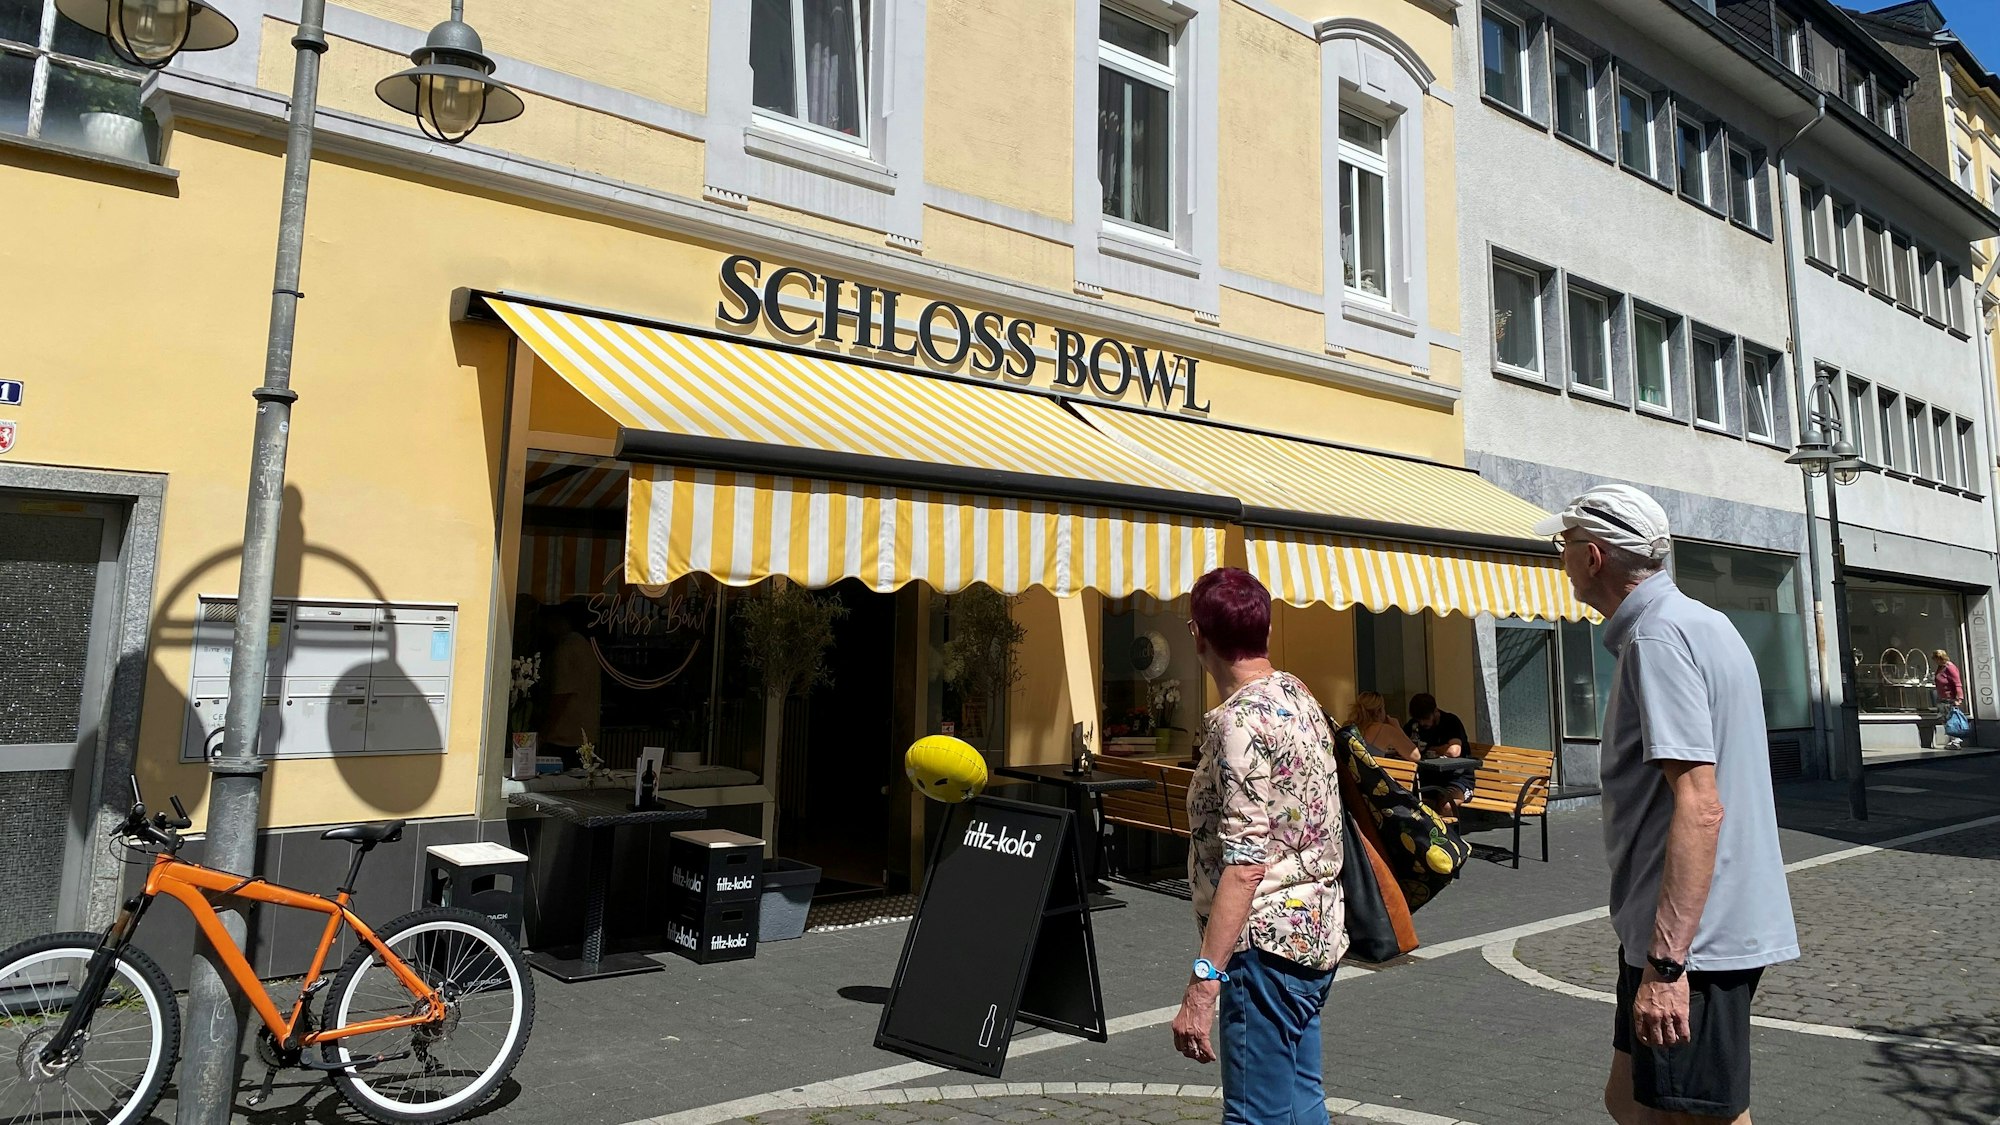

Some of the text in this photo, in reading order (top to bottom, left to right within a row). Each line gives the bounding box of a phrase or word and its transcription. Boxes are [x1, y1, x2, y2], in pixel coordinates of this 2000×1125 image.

[717, 255, 1211, 414] SCHLOSS BOWL
[665, 594, 714, 636] Bowl
[1972, 609, 1994, 706] GOLDSCHMIDE
